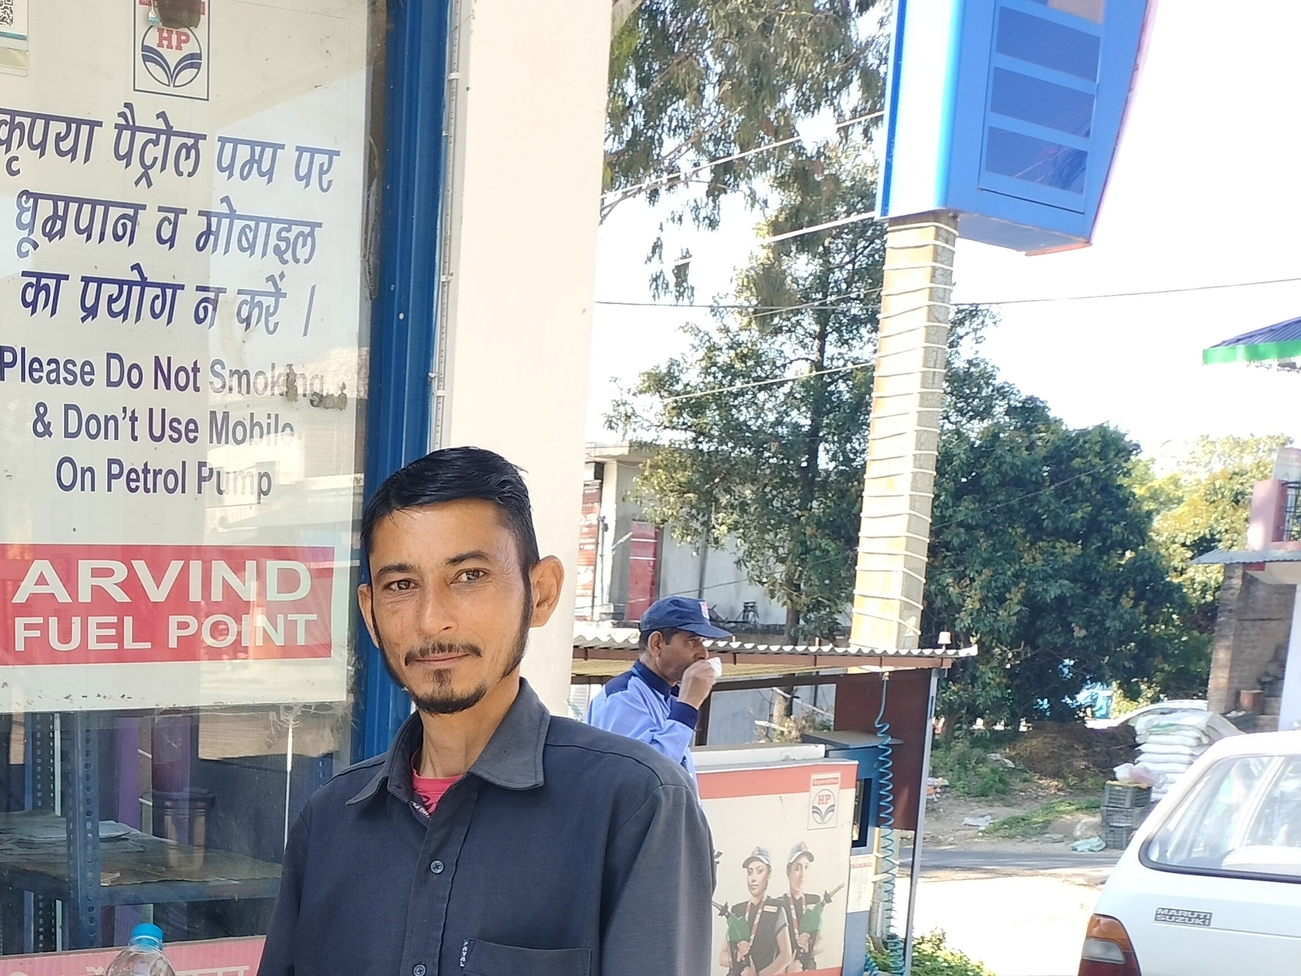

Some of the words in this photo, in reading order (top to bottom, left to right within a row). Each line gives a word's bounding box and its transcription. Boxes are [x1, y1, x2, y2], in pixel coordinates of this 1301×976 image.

[157, 28, 190, 51] HP
[113, 102, 207, 188] पैट्रोल
[216, 135, 285, 186] पम्प
[295, 144, 341, 193] पर
[15, 189, 147, 258] धूम्रपान
[156, 206, 188, 250] व
[195, 195, 323, 265] मोबाइल
[20, 270, 69, 318] का
[80, 263, 184, 326] प्रयोग
[193, 285, 226, 330] न
[236, 272, 287, 336] करें
[0, 345, 95, 387] Please
[106, 352, 143, 389] Do
[153, 355, 200, 393] Not
[32, 401, 53, 439] &
[63, 402, 138, 442] Don't
[148, 407, 199, 444] Use
[209, 410, 295, 446] Mobile
[56, 456, 95, 492] On
[106, 457, 187, 494] Petrol
[197, 461, 272, 505] Pump
[11, 559, 312, 604] ARVIND
[15, 616, 151, 651] FUEL
[168, 613, 318, 648] POINT
[818, 794, 831, 805] HP
[1156, 915, 1210, 926] SUZUKI
[1157, 908, 1212, 919] MARUTI
